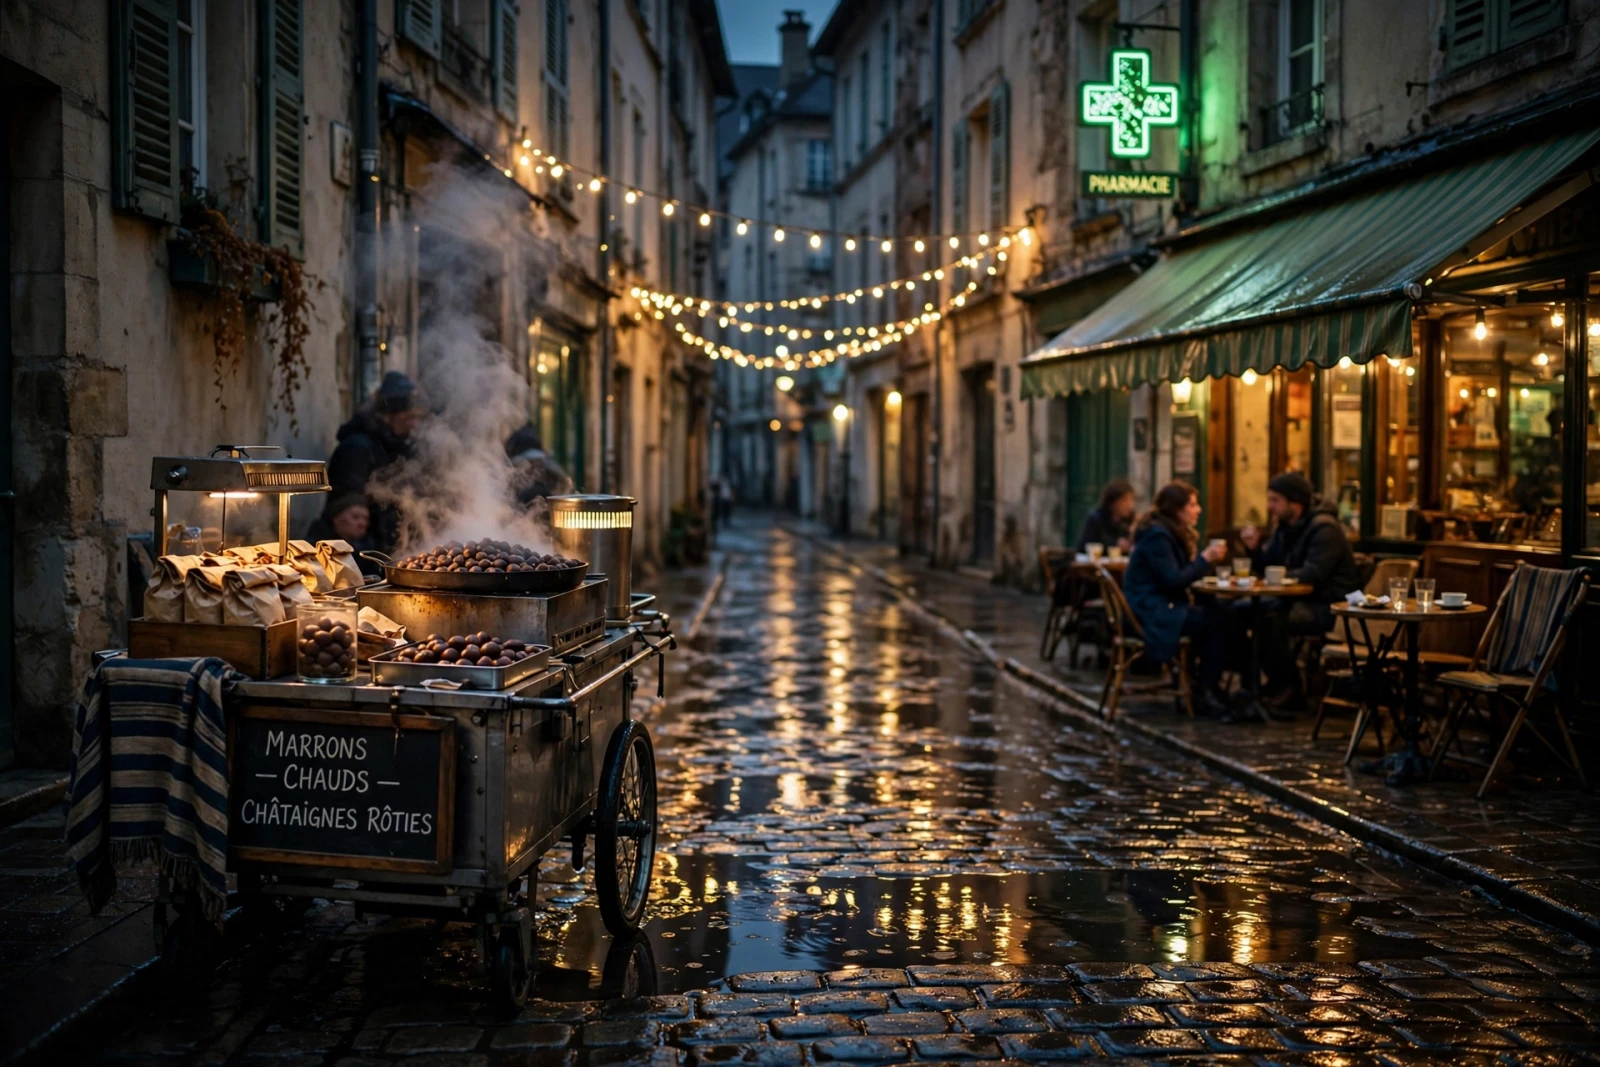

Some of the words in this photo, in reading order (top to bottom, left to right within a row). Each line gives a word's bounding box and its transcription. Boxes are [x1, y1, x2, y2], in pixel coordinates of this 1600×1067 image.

[1089, 174, 1171, 194] PHARMACIE
[265, 730, 367, 760] MARRONS
[283, 763, 369, 793] CHAUDS
[367, 805, 432, 835] RÔTIES
